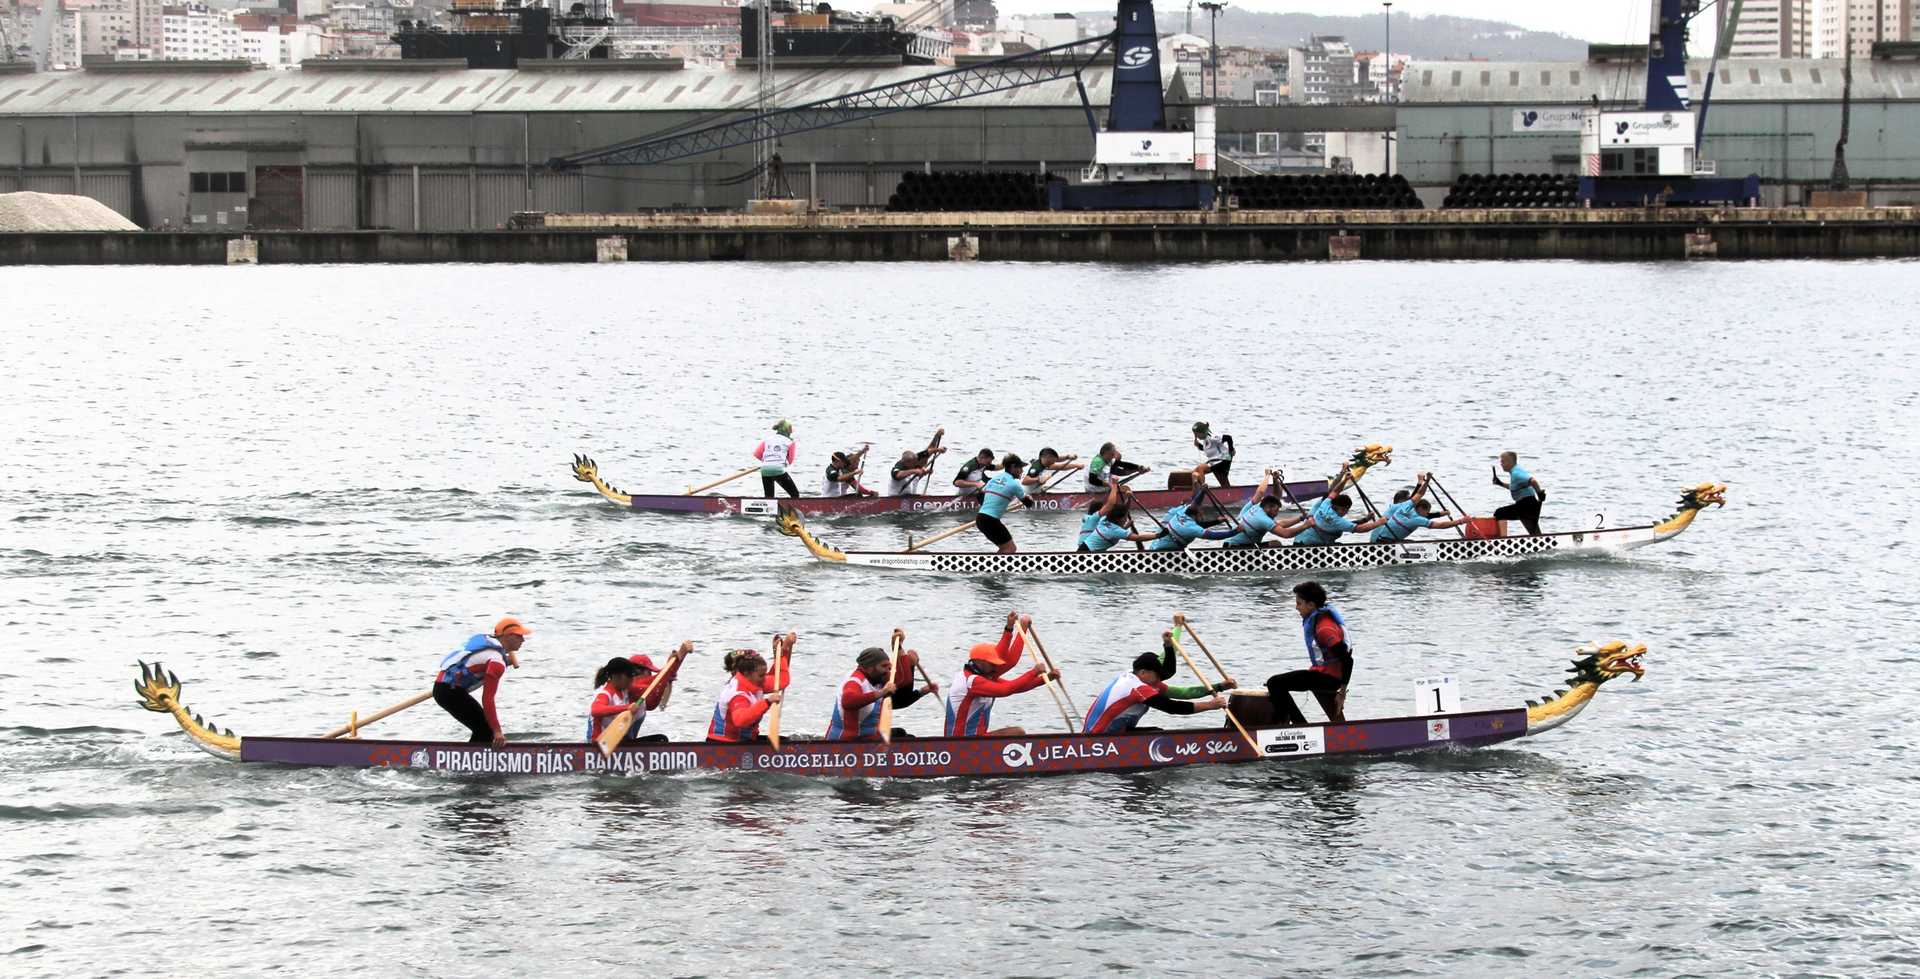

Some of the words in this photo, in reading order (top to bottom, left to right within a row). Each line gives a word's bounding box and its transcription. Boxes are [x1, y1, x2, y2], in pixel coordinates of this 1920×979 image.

[1594, 513, 1606, 530] 2
[1432, 687, 1446, 713] 1
[1038, 742, 1120, 761] JEALSA
[1175, 743, 1201, 755] we
[1206, 741, 1238, 754] sea
[436, 748, 532, 774] PIRAGÜISMO
[536, 748, 574, 774] RÍAS
[650, 750, 698, 771] BOIRO
[758, 752, 858, 768] CONCELLO
[863, 753, 888, 767] DE
[893, 751, 952, 766] BOIRO
